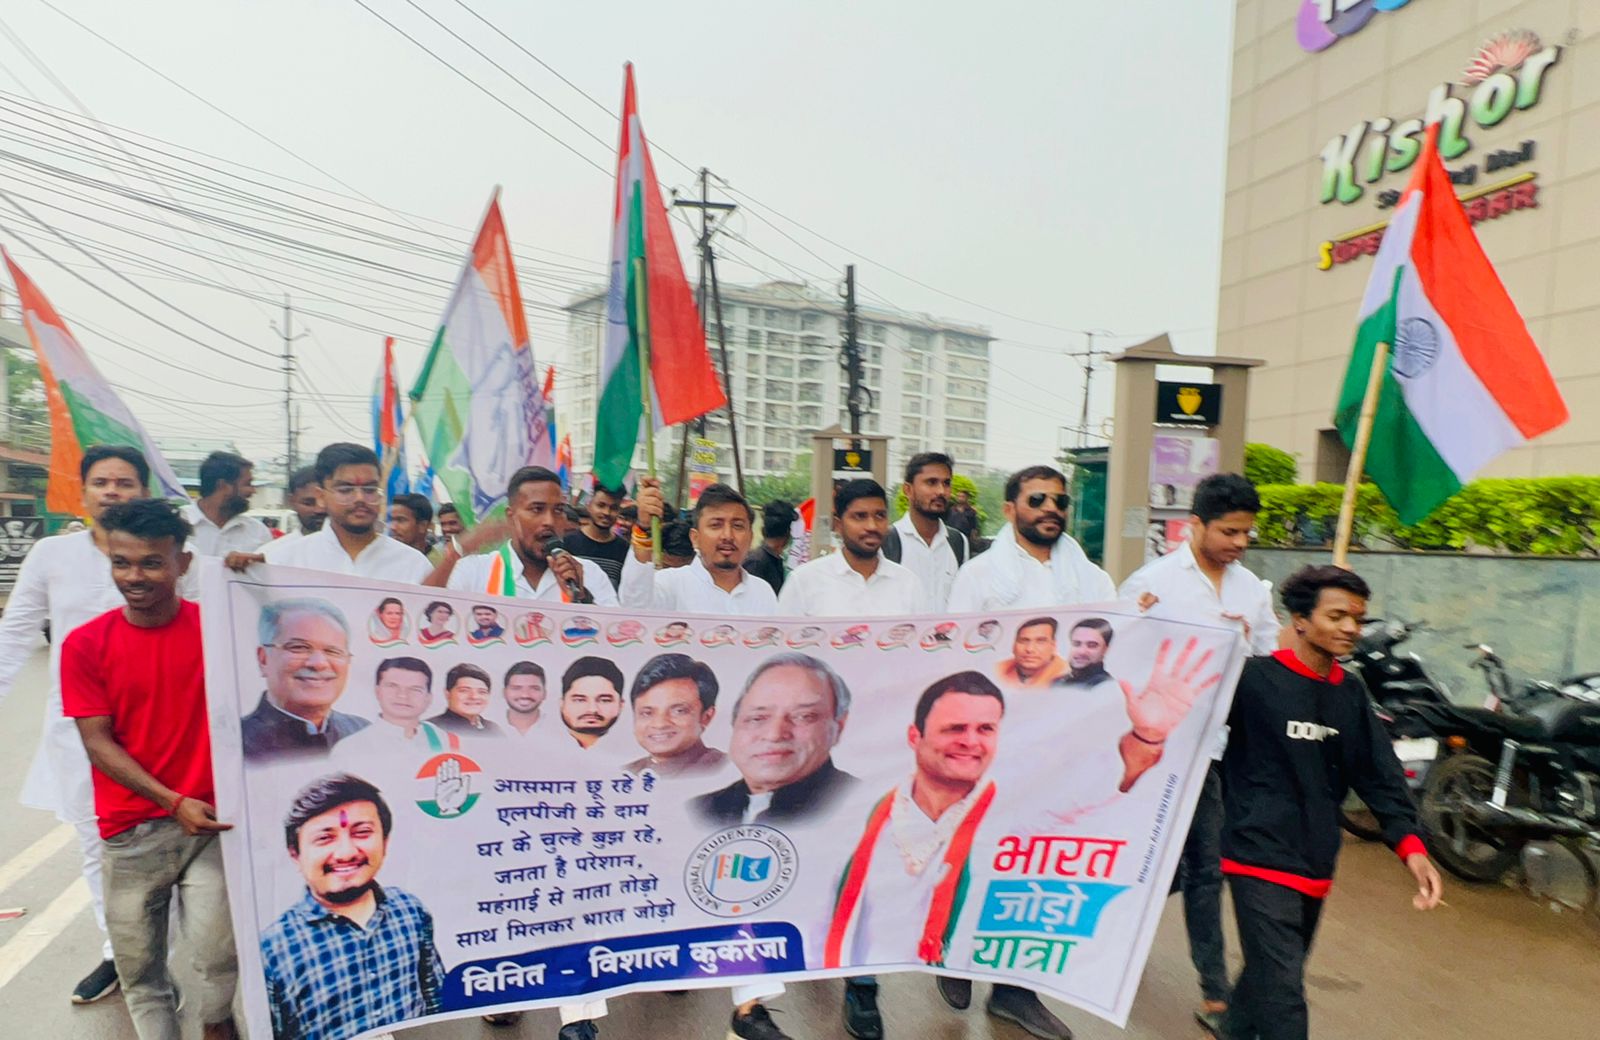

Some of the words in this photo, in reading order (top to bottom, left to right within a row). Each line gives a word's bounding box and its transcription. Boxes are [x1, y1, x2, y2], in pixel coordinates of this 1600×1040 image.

[1321, 45, 1562, 205] Kishor
[494, 779, 576, 794] आसमान
[585, 780, 604, 800] छू
[610, 774, 634, 794] रहे
[642, 772, 656, 792] है
[497, 802, 576, 825] एलपीजी
[586, 801, 605, 818] के
[615, 804, 649, 817] दाम
[477, 841, 503, 856] घर
[512, 830, 531, 851] के
[540, 827, 583, 853] चुल्हे
[592, 831, 625, 849] बुझ
[767, 834, 793, 864] UNION
[993, 835, 1128, 879] भारत
[494, 865, 547, 884] जनता
[555, 855, 567, 878] है
[690, 865, 719, 910] NATIONAL
[781, 867, 792, 883] OF
[477, 888, 540, 914] महंगाई
[548, 886, 563, 906] से
[573, 883, 611, 900] नाता
[620, 873, 658, 897] तोड़ो
[752, 884, 785, 908] INDIA
[993, 882, 1089, 933] जोड़ो
[456, 928, 498, 948] साथ
[507, 917, 575, 941] मिलकर
[584, 908, 625, 925] भारत
[635, 898, 675, 923] जोड़ो
[461, 961, 547, 996] विनित
[588, 945, 680, 978] विशाल
[688, 930, 787, 974] कुकरेजा
[972, 935, 1077, 974] यात्रा
